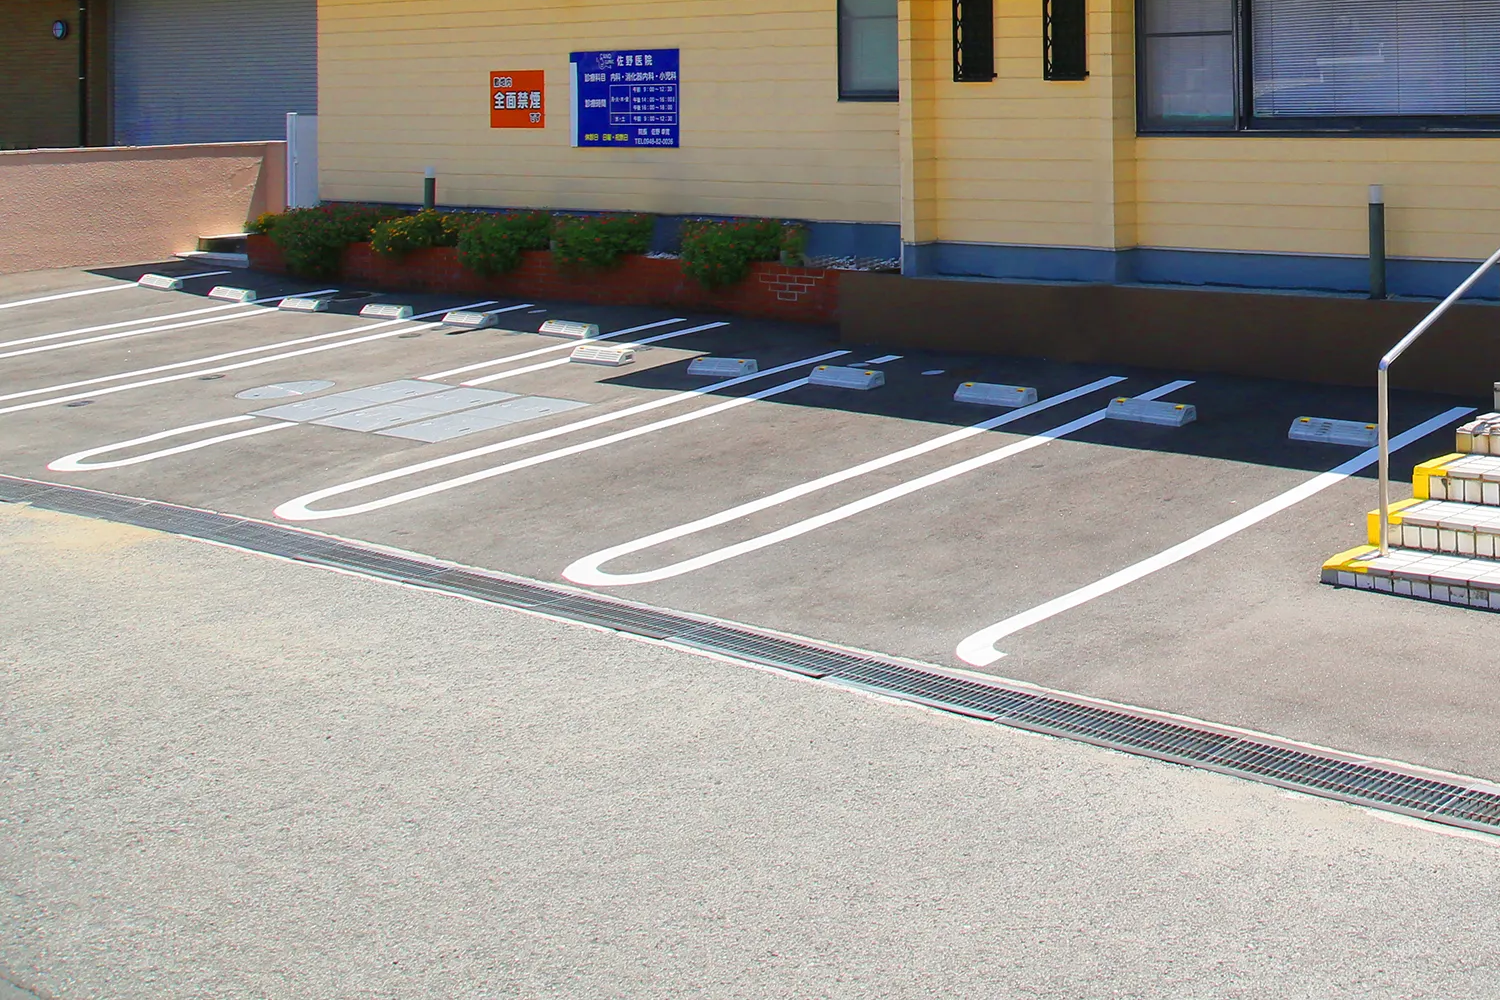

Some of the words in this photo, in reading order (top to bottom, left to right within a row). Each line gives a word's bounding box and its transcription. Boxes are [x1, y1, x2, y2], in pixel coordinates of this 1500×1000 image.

[617, 54, 653, 67] 佐野医院
[494, 91, 541, 109] 全面禁煙
